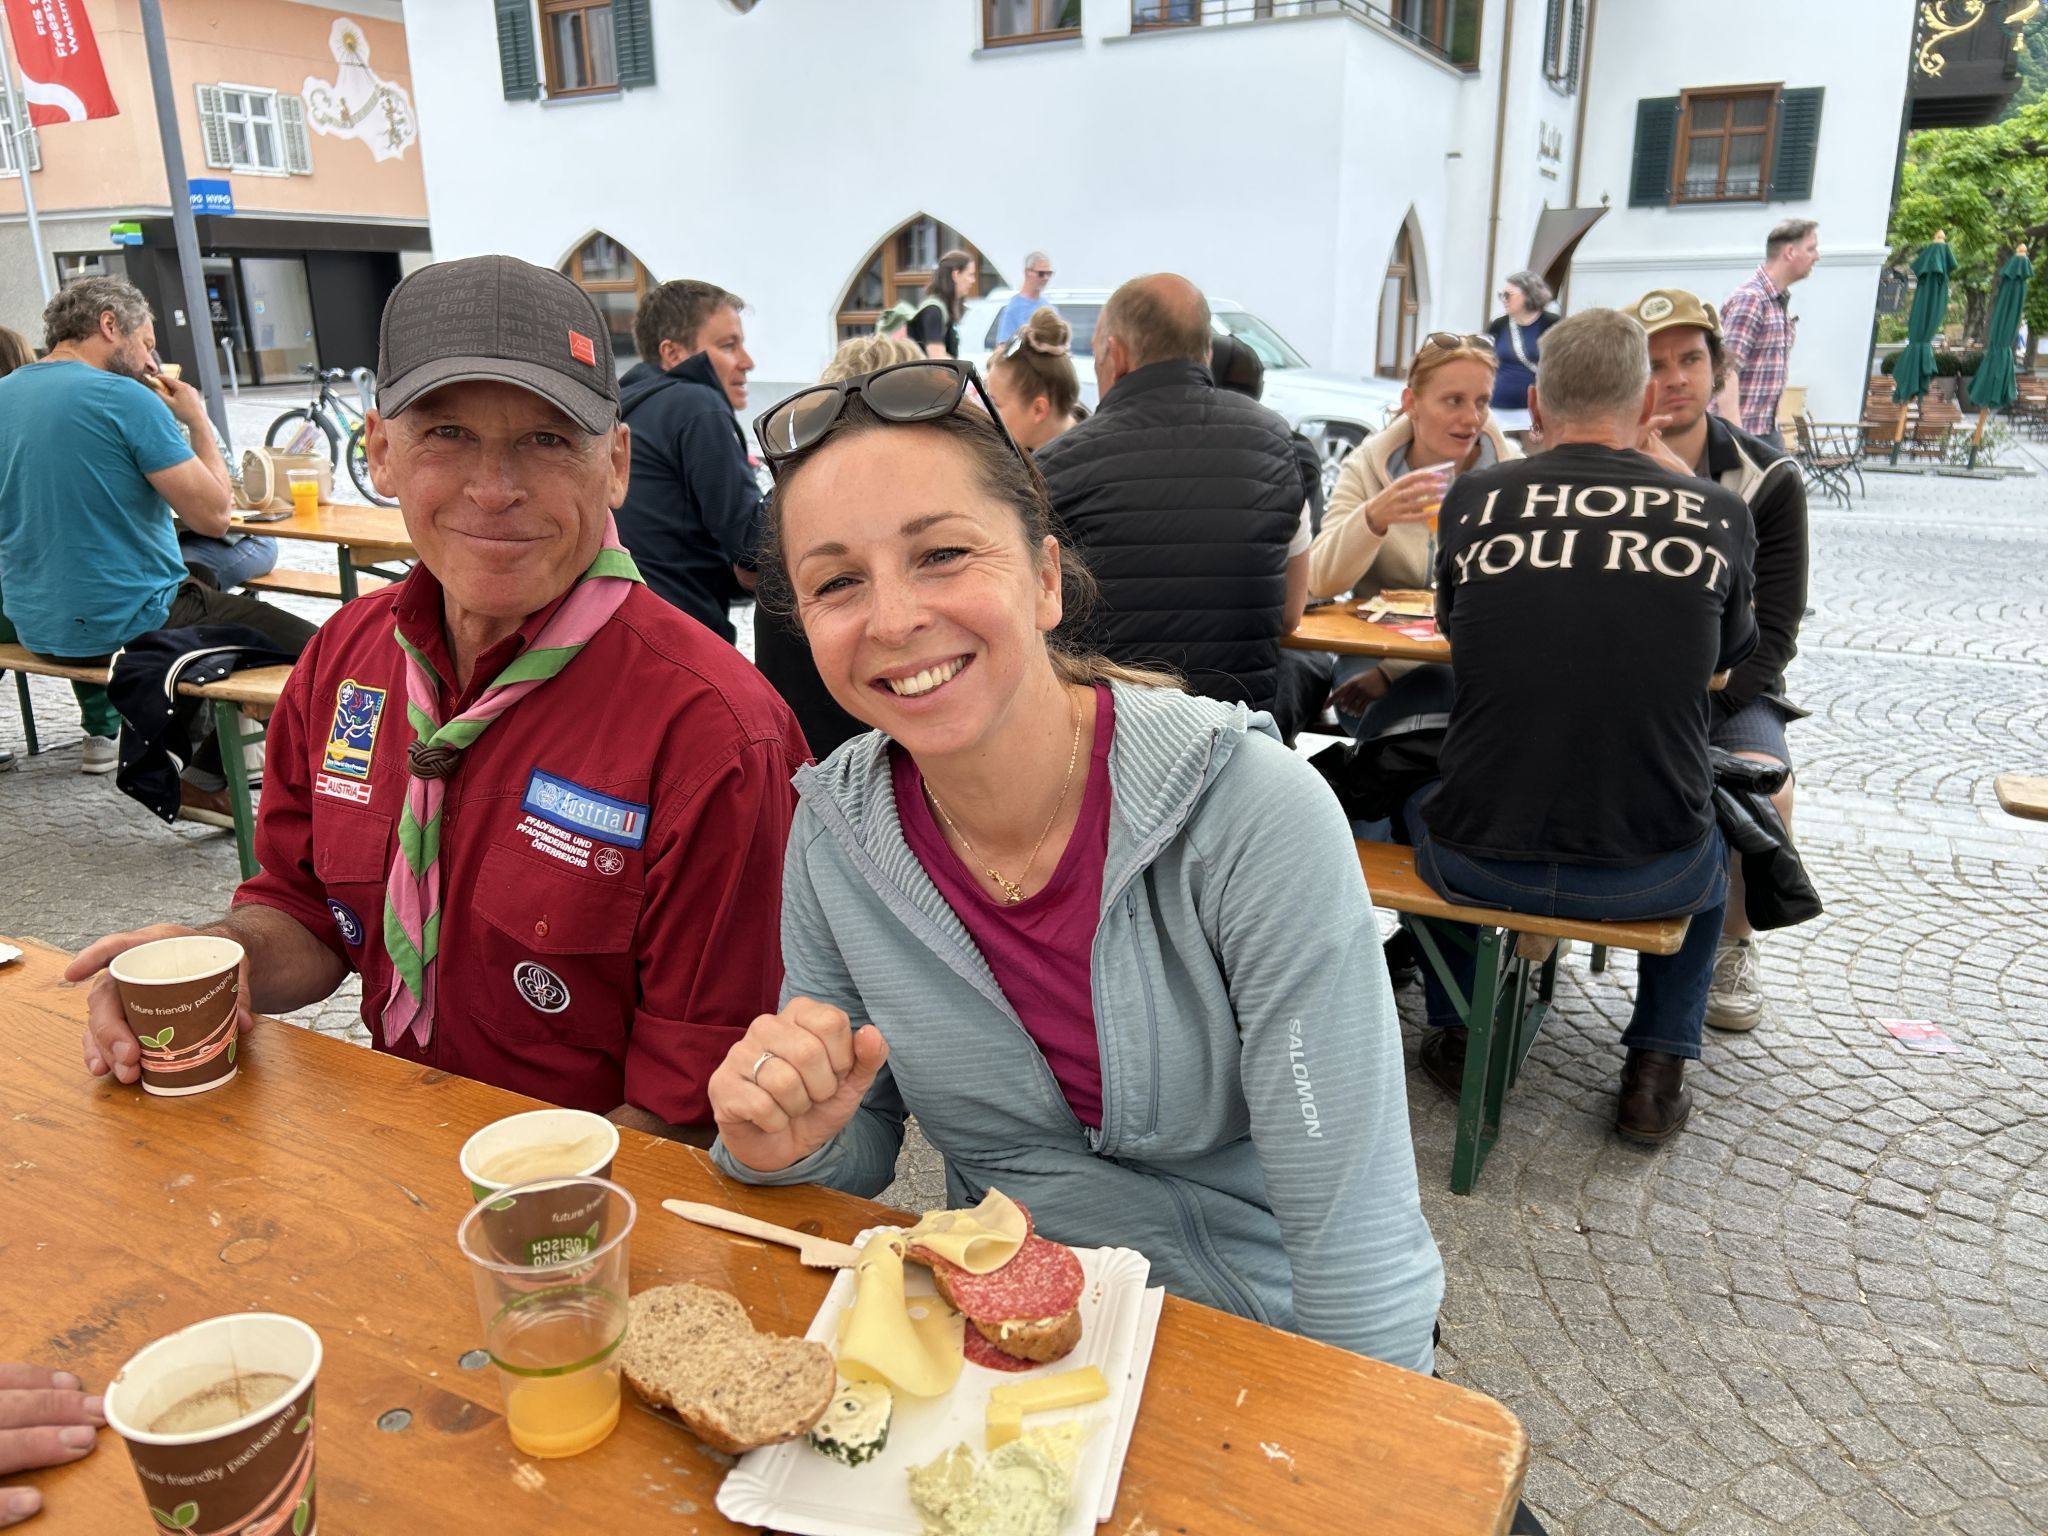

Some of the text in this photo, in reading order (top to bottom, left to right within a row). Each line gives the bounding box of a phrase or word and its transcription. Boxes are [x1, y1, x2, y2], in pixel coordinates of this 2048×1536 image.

[32, 9, 46, 36] FIS
[1478, 483, 1709, 529] I HOPE
[1455, 529, 1729, 592] YOU ROT
[328, 781, 358, 798] AUSTRIA
[560, 792, 620, 828] Austria
[516, 823, 591, 859] PFADFINDERINNEN
[525, 816, 572, 841] PFADFINDER
[573, 836, 592, 849] UND
[531, 839, 588, 868] ÖSTERREICHS
[130, 971, 234, 1015] future friendly packaging
[1289, 1019, 1322, 1137] SALOMON
[551, 1209, 585, 1223] future
[166, 1465, 225, 1487] friendly
[226, 1404, 297, 1474] packaging
